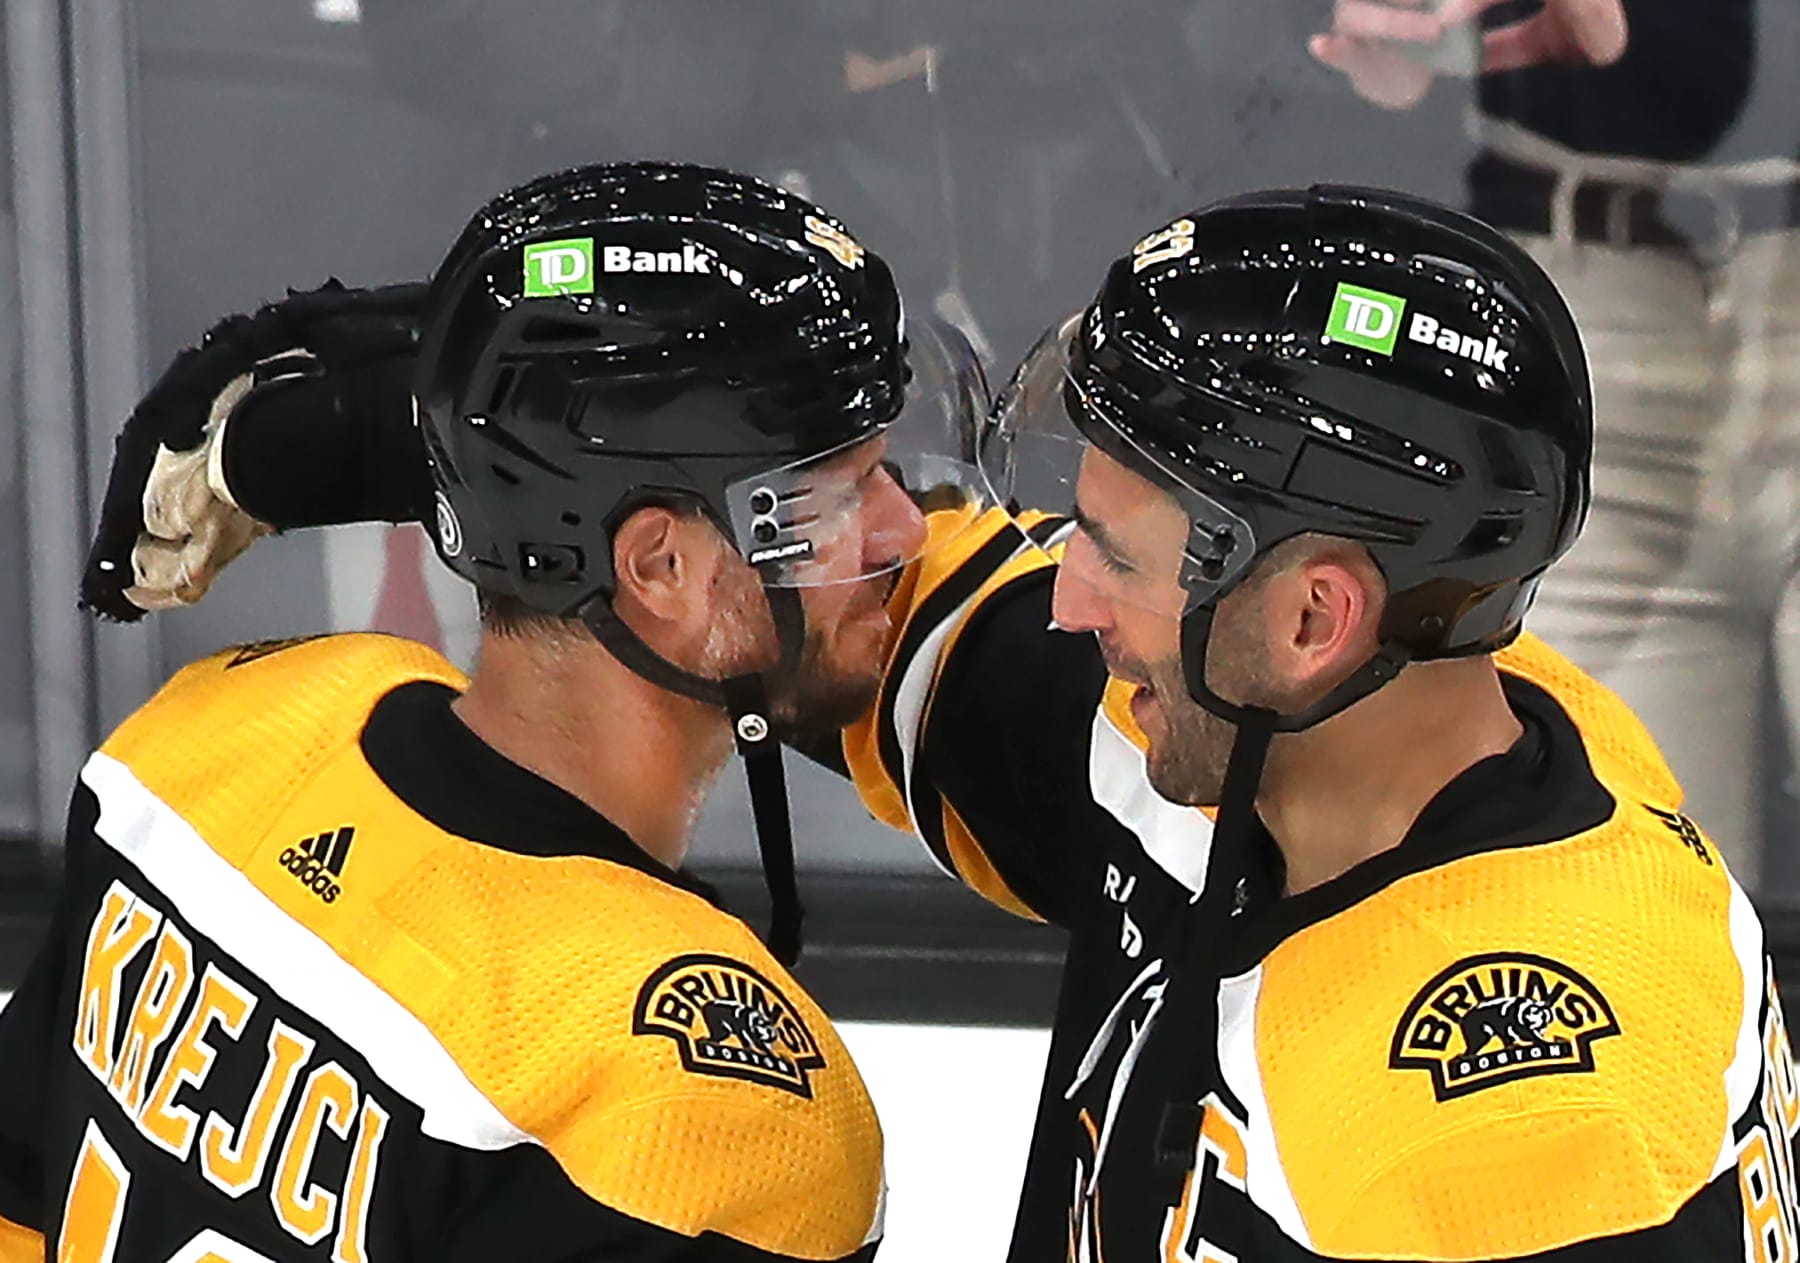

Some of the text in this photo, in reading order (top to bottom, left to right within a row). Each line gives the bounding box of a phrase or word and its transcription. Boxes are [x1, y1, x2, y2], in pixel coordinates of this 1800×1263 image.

[530, 245, 711, 287] TD Bank
[1340, 293, 1509, 373] TD Bank
[279, 847, 341, 904] adidas
[655, 971, 809, 1054] BRUINS
[1409, 968, 1597, 1052] BRUINS
[73, 879, 391, 1263] KREJCI
[1459, 1044, 1562, 1076] BOSTON
